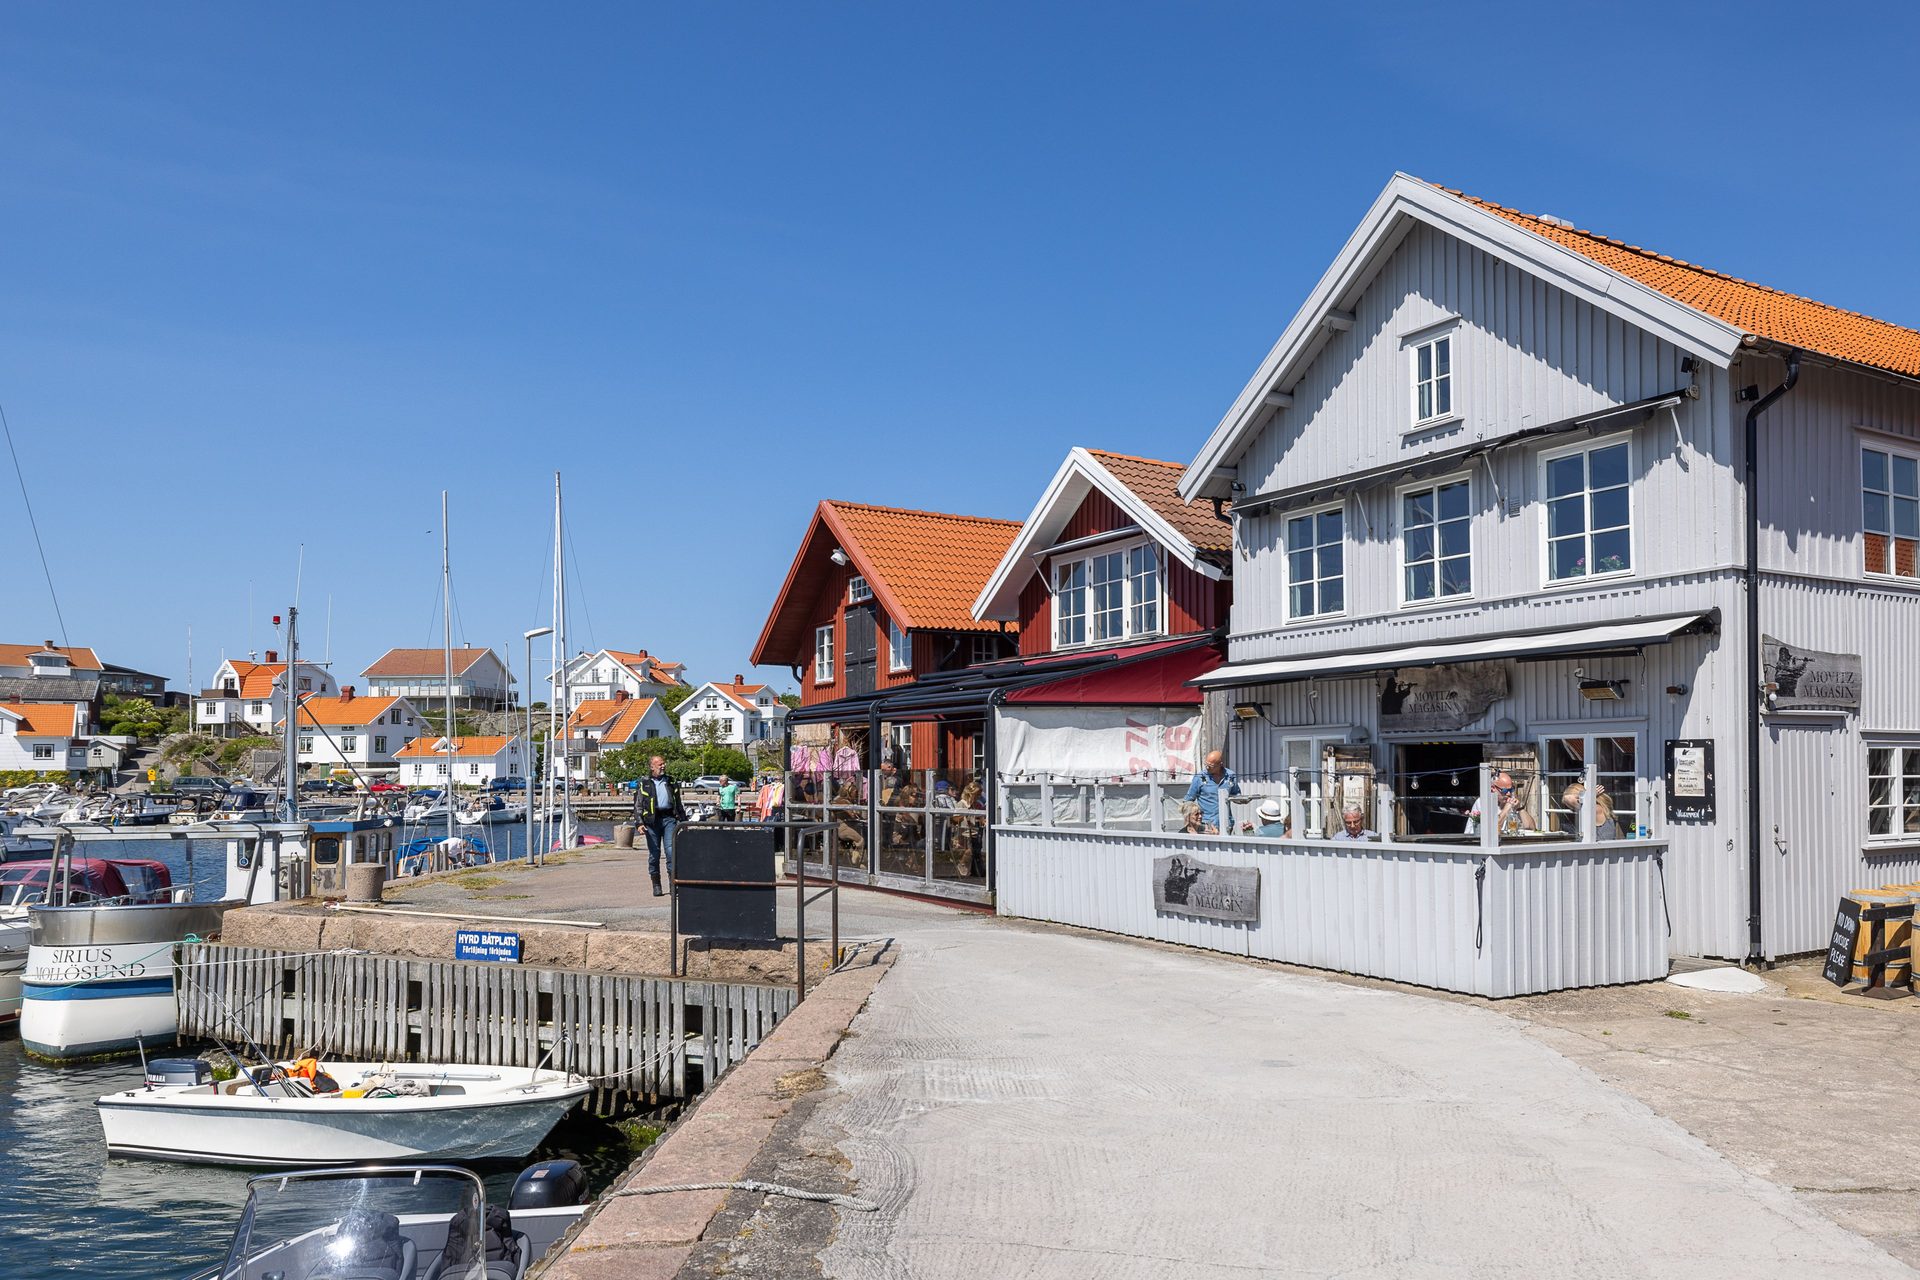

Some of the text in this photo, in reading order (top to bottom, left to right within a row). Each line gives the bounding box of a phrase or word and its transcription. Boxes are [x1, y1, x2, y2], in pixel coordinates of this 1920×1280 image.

[1802, 684, 1854, 699] MAGASIN
[1408, 702, 1453, 714] MAGASIN
[1194, 894, 1243, 914] MAGASIN
[458, 932, 517, 947] HYRD BÅTPLATS
[52, 947, 112, 964] SIRIUS
[1829, 947, 1846, 968] PLEASE
